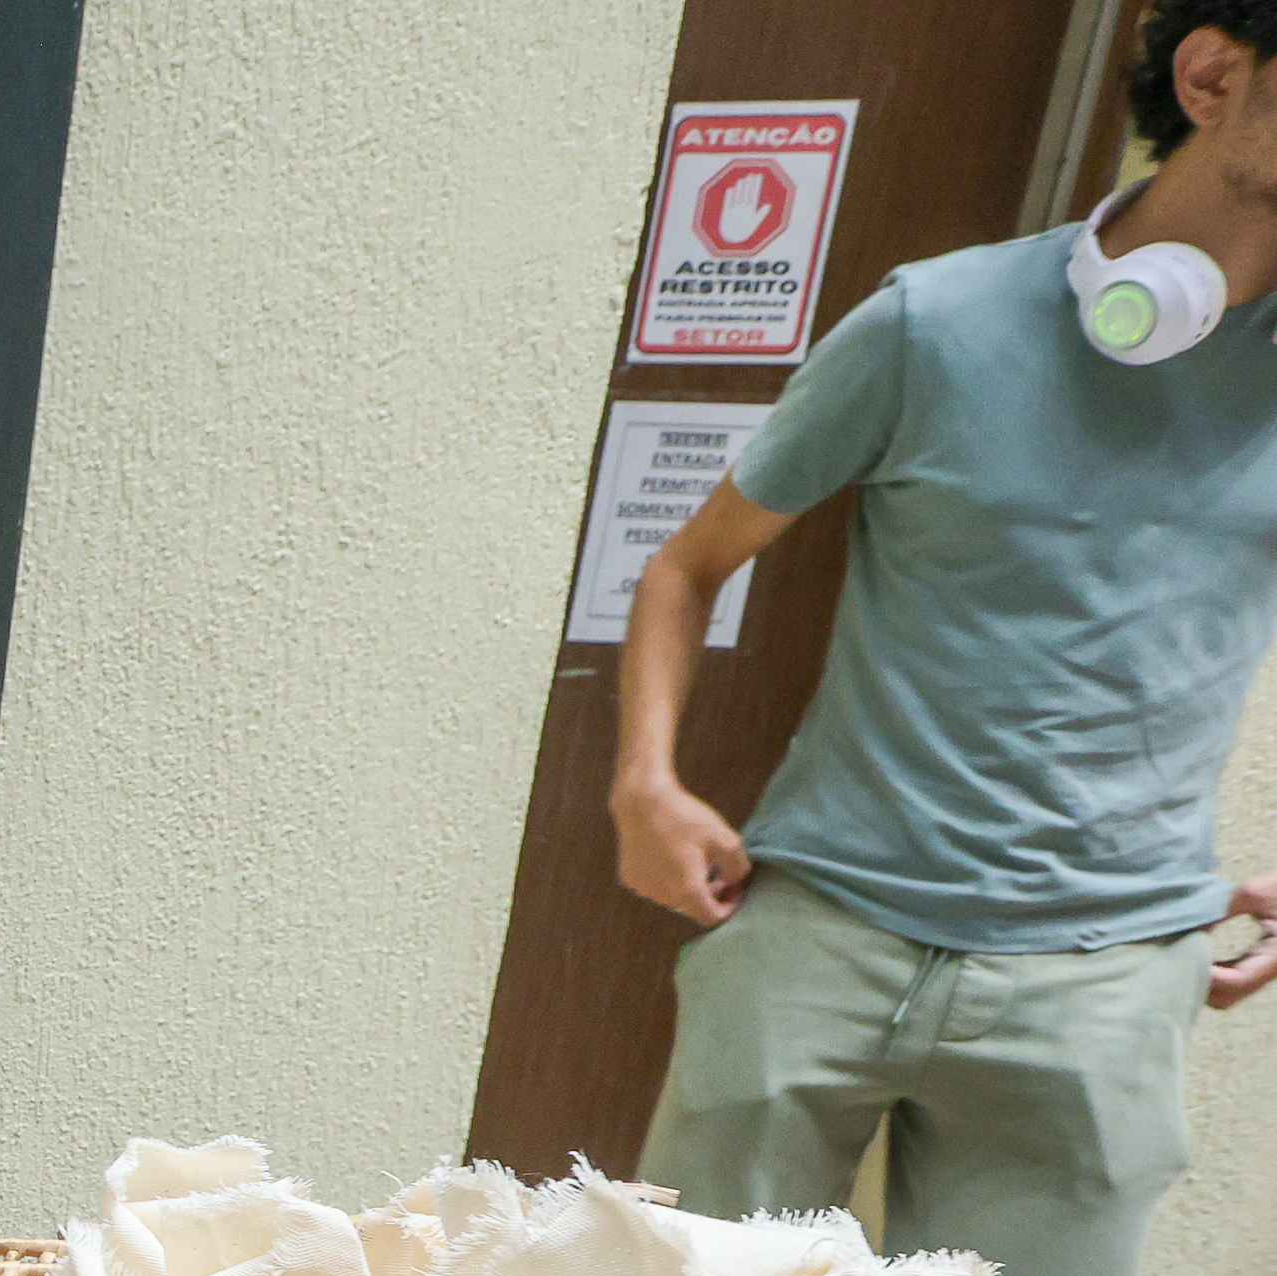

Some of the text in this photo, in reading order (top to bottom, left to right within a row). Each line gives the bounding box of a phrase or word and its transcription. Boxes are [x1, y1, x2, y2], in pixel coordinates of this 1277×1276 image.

[680, 121, 837, 148] ATENÇÃO
[675, 260, 790, 275] ACESSO
[659, 279, 798, 294] RESTRITO
[673, 328, 765, 345] SETOR
